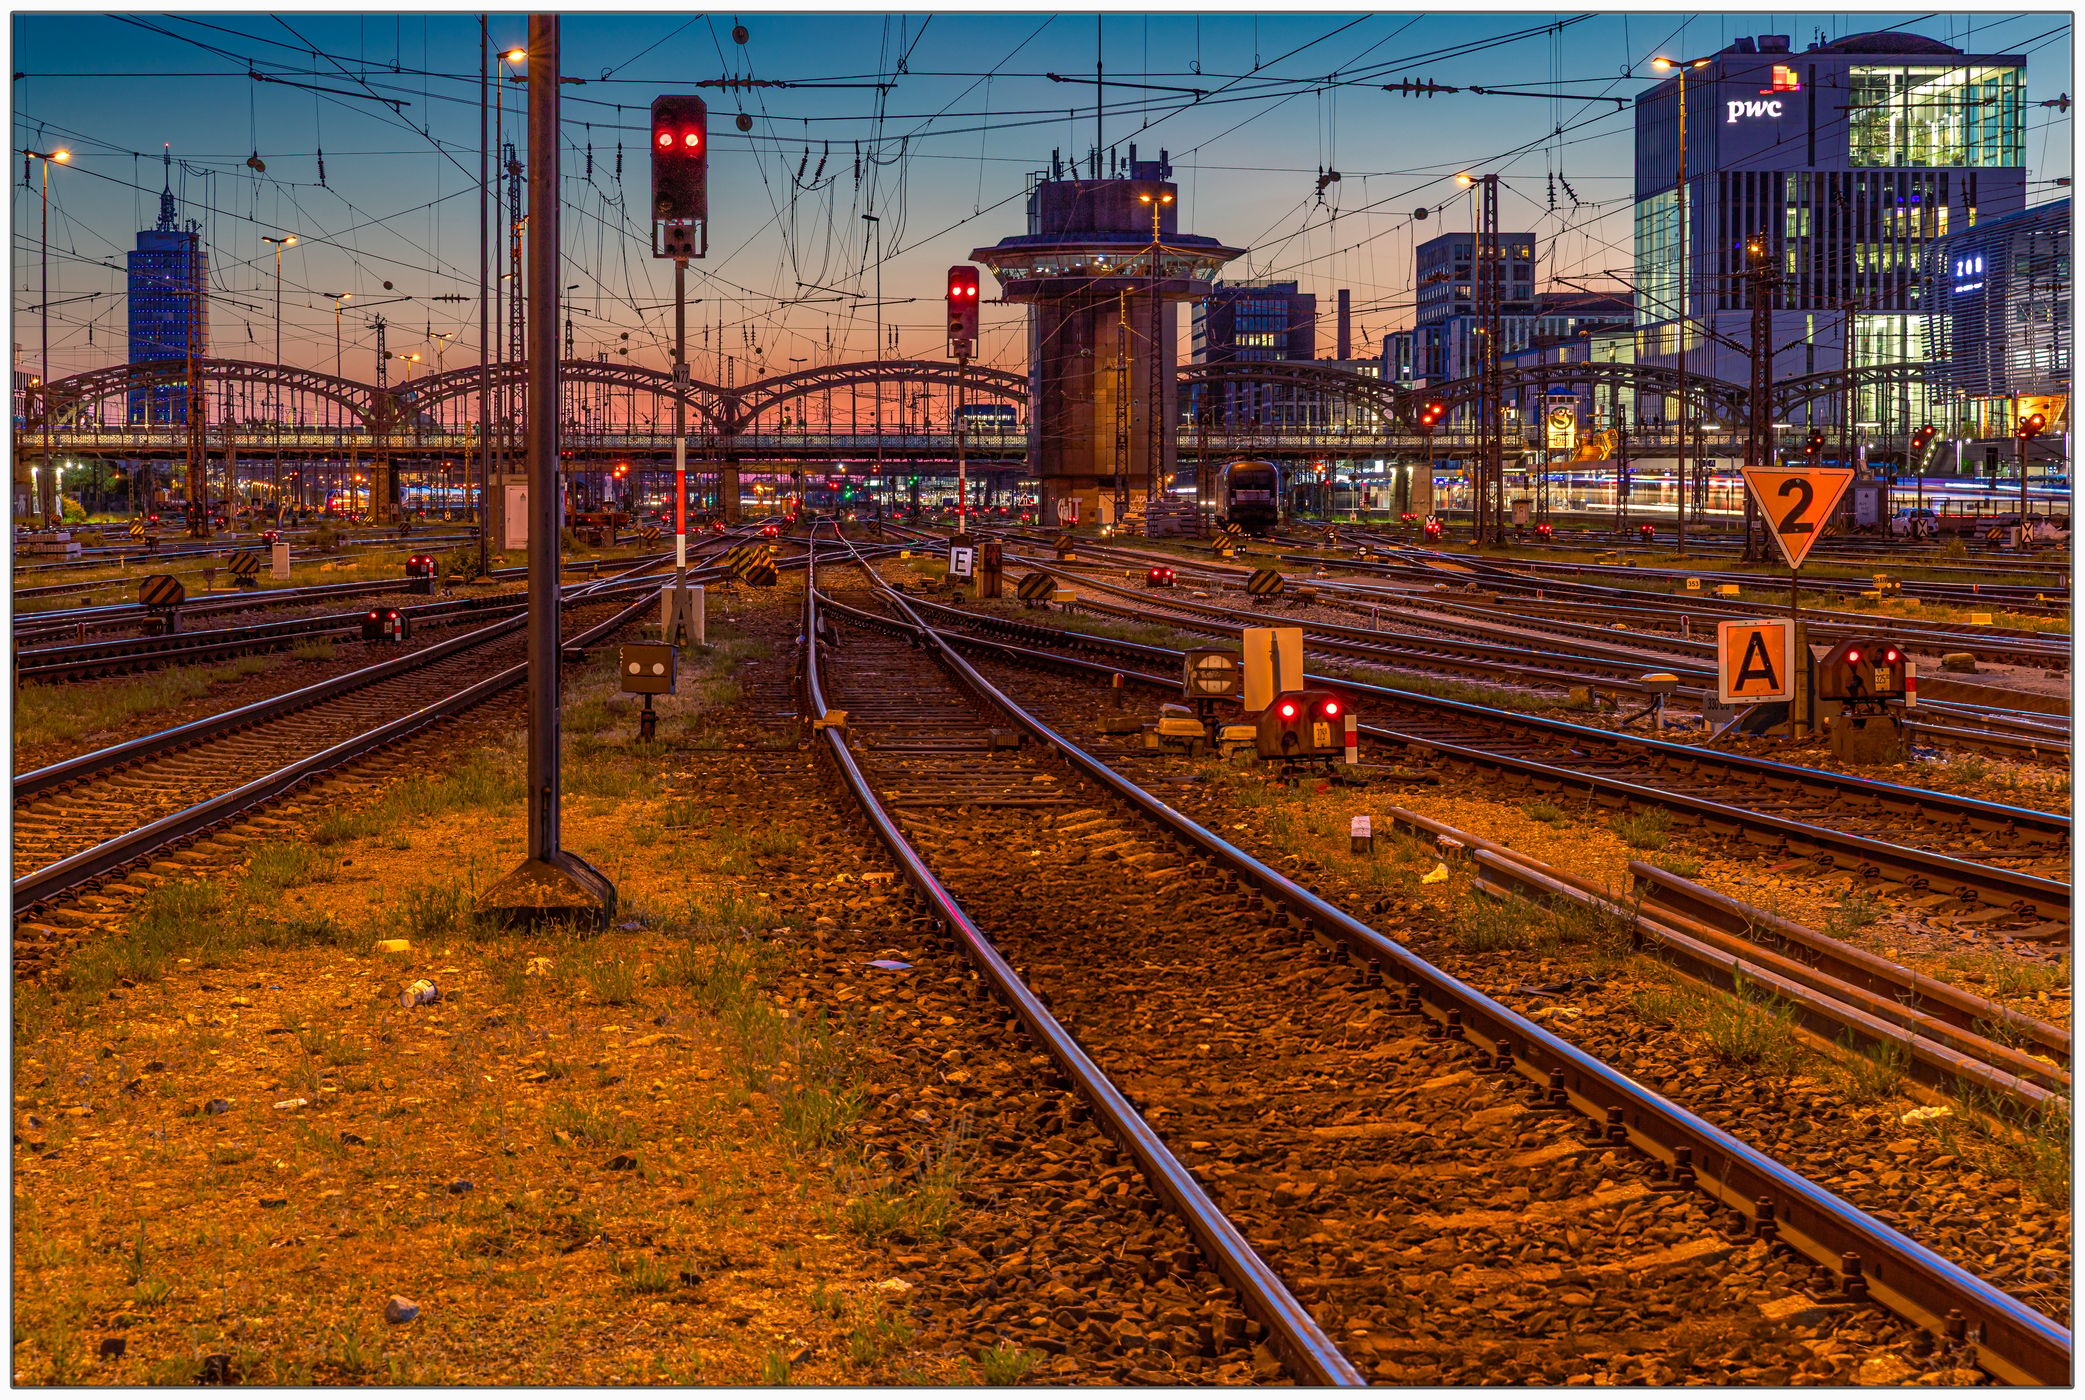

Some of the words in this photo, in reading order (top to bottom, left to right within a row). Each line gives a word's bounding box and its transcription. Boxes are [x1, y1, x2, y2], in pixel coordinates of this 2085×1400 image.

[1727, 100, 1782, 123] pwc
[1777, 477, 1814, 534] 2
[955, 551, 968, 572] E
[1733, 631, 1780, 691] A
